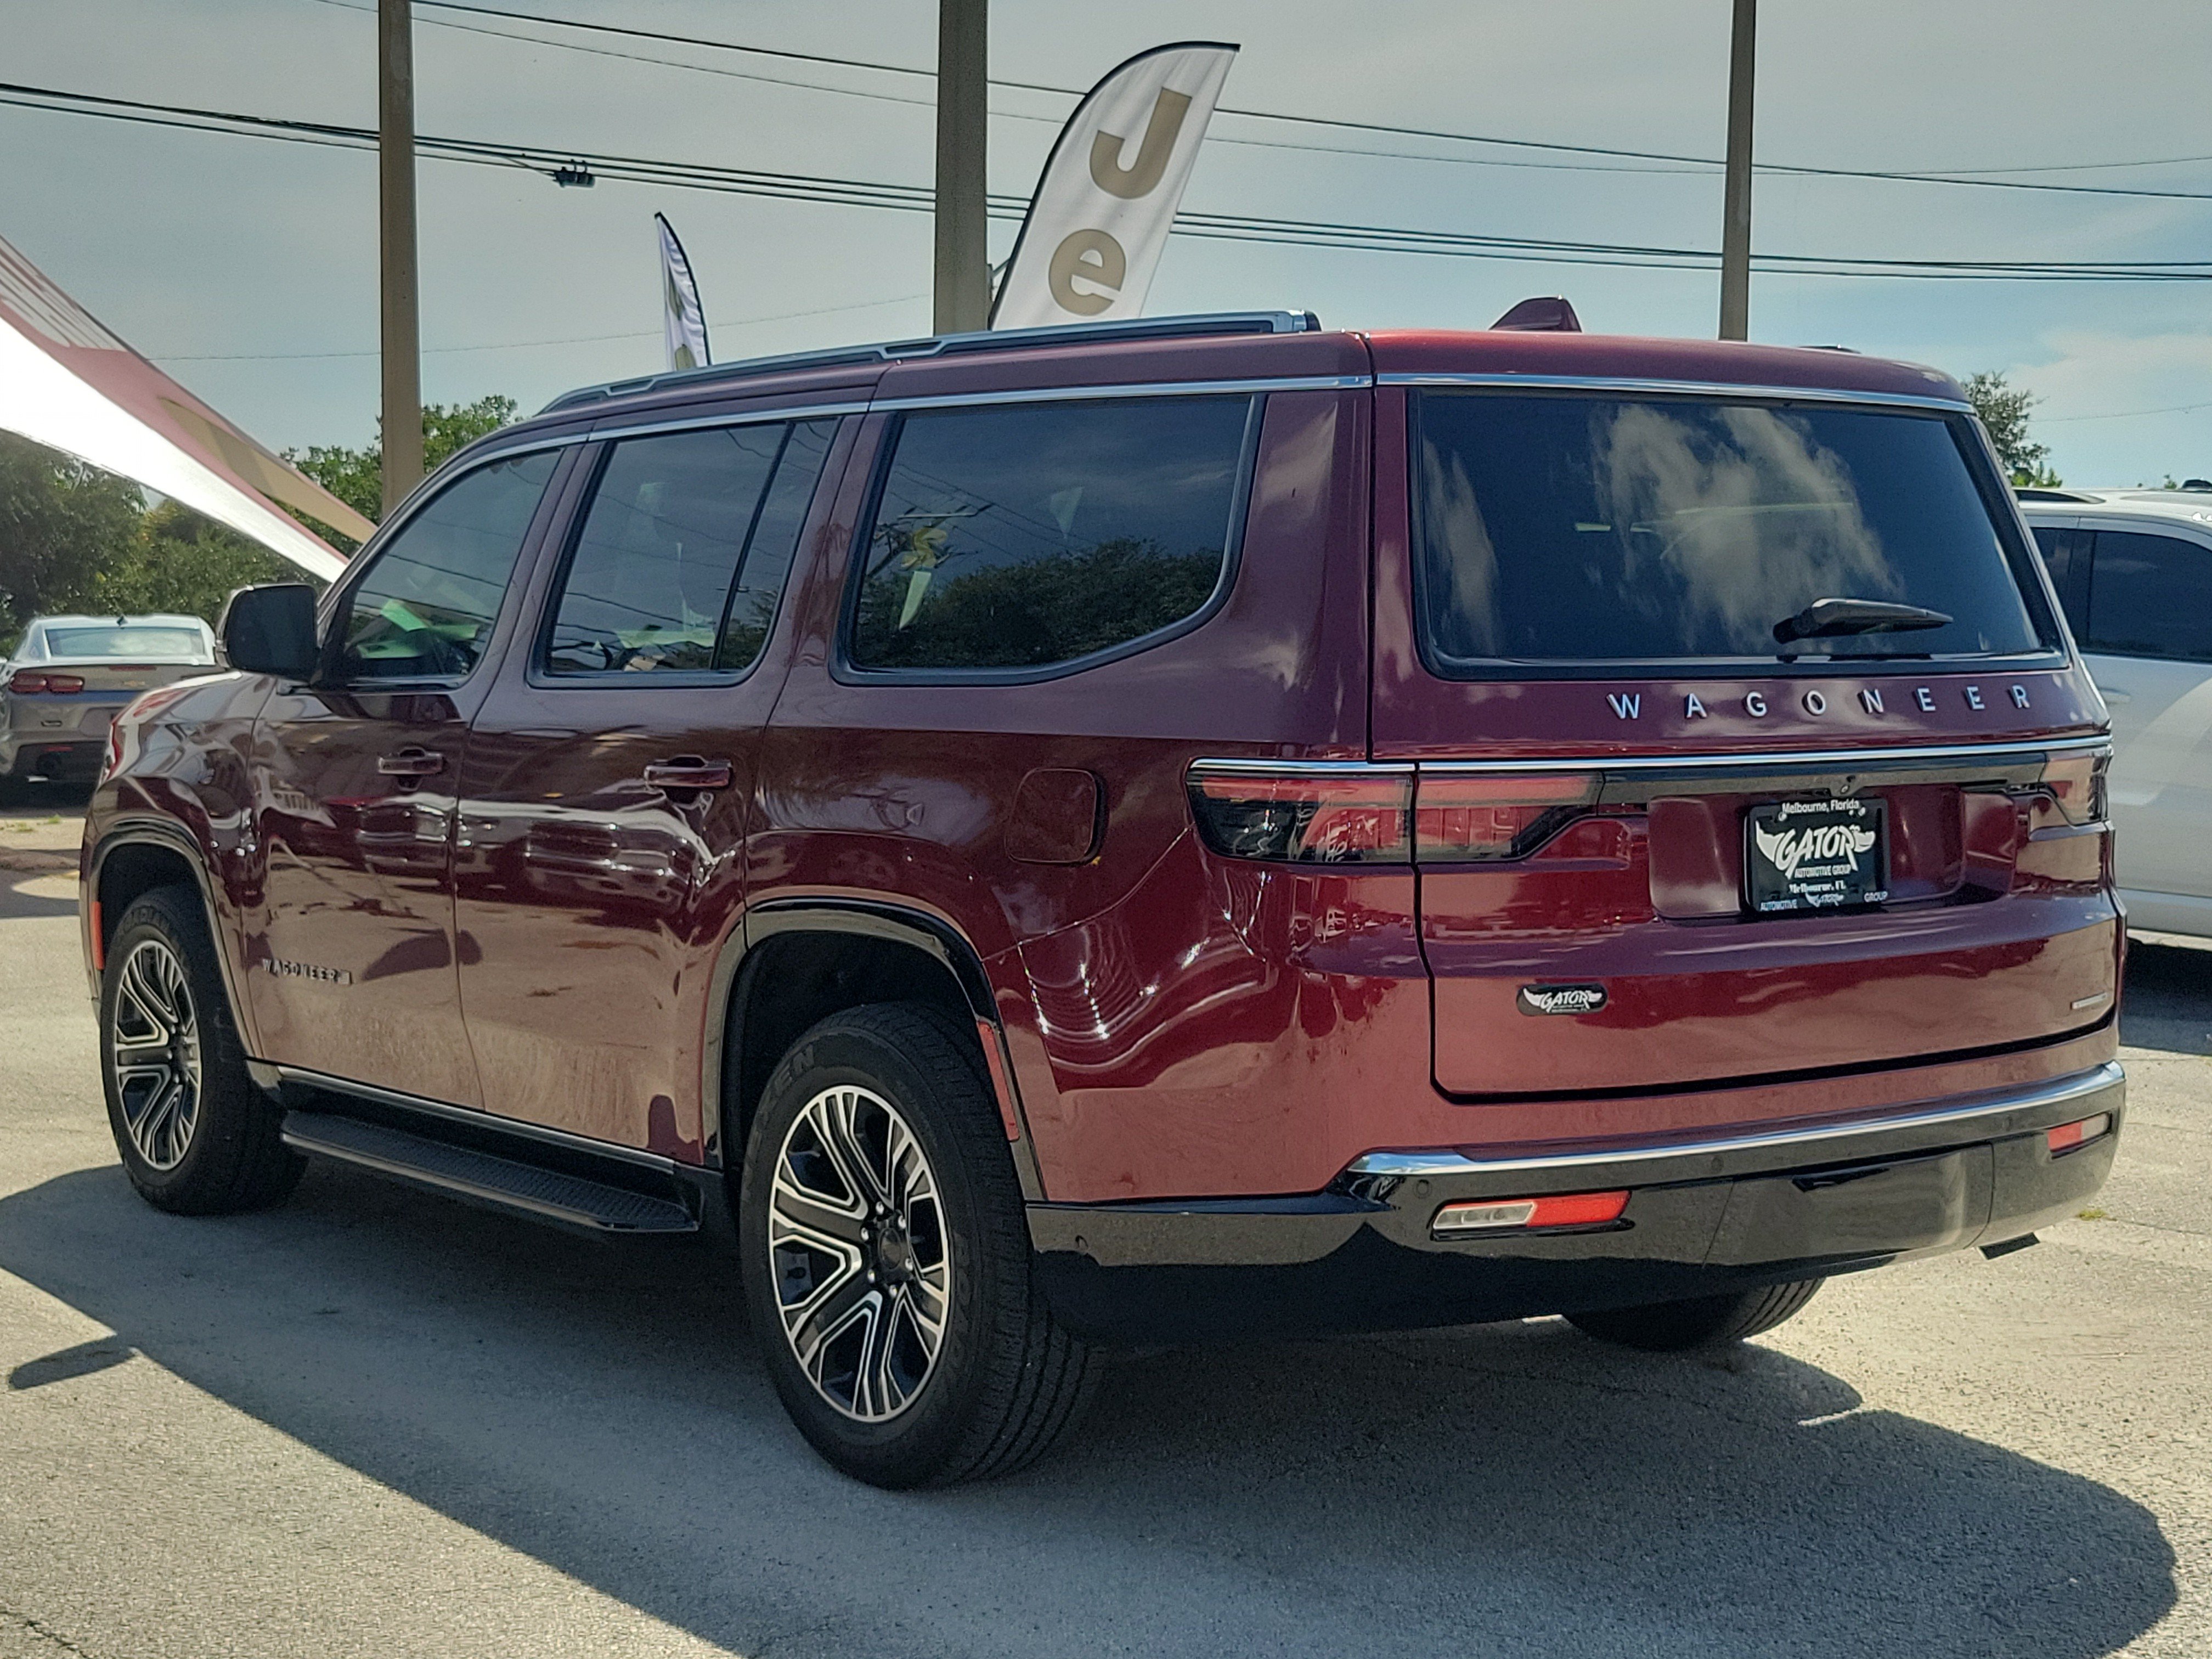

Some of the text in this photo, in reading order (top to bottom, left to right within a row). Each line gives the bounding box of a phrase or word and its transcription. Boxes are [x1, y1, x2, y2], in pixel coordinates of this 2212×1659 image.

[1606, 685, 2030, 719] WAGONEER
[1782, 798, 1860, 813] Melbourne, Florida
[1774, 825, 1859, 880] GATOR
[1795, 864, 1852, 878] AUTOMOTIVE GROUP
[1864, 891, 1888, 902] GROUP
[262, 958, 338, 983] WAGONEER
[1539, 990, 1590, 1013] GATOR
